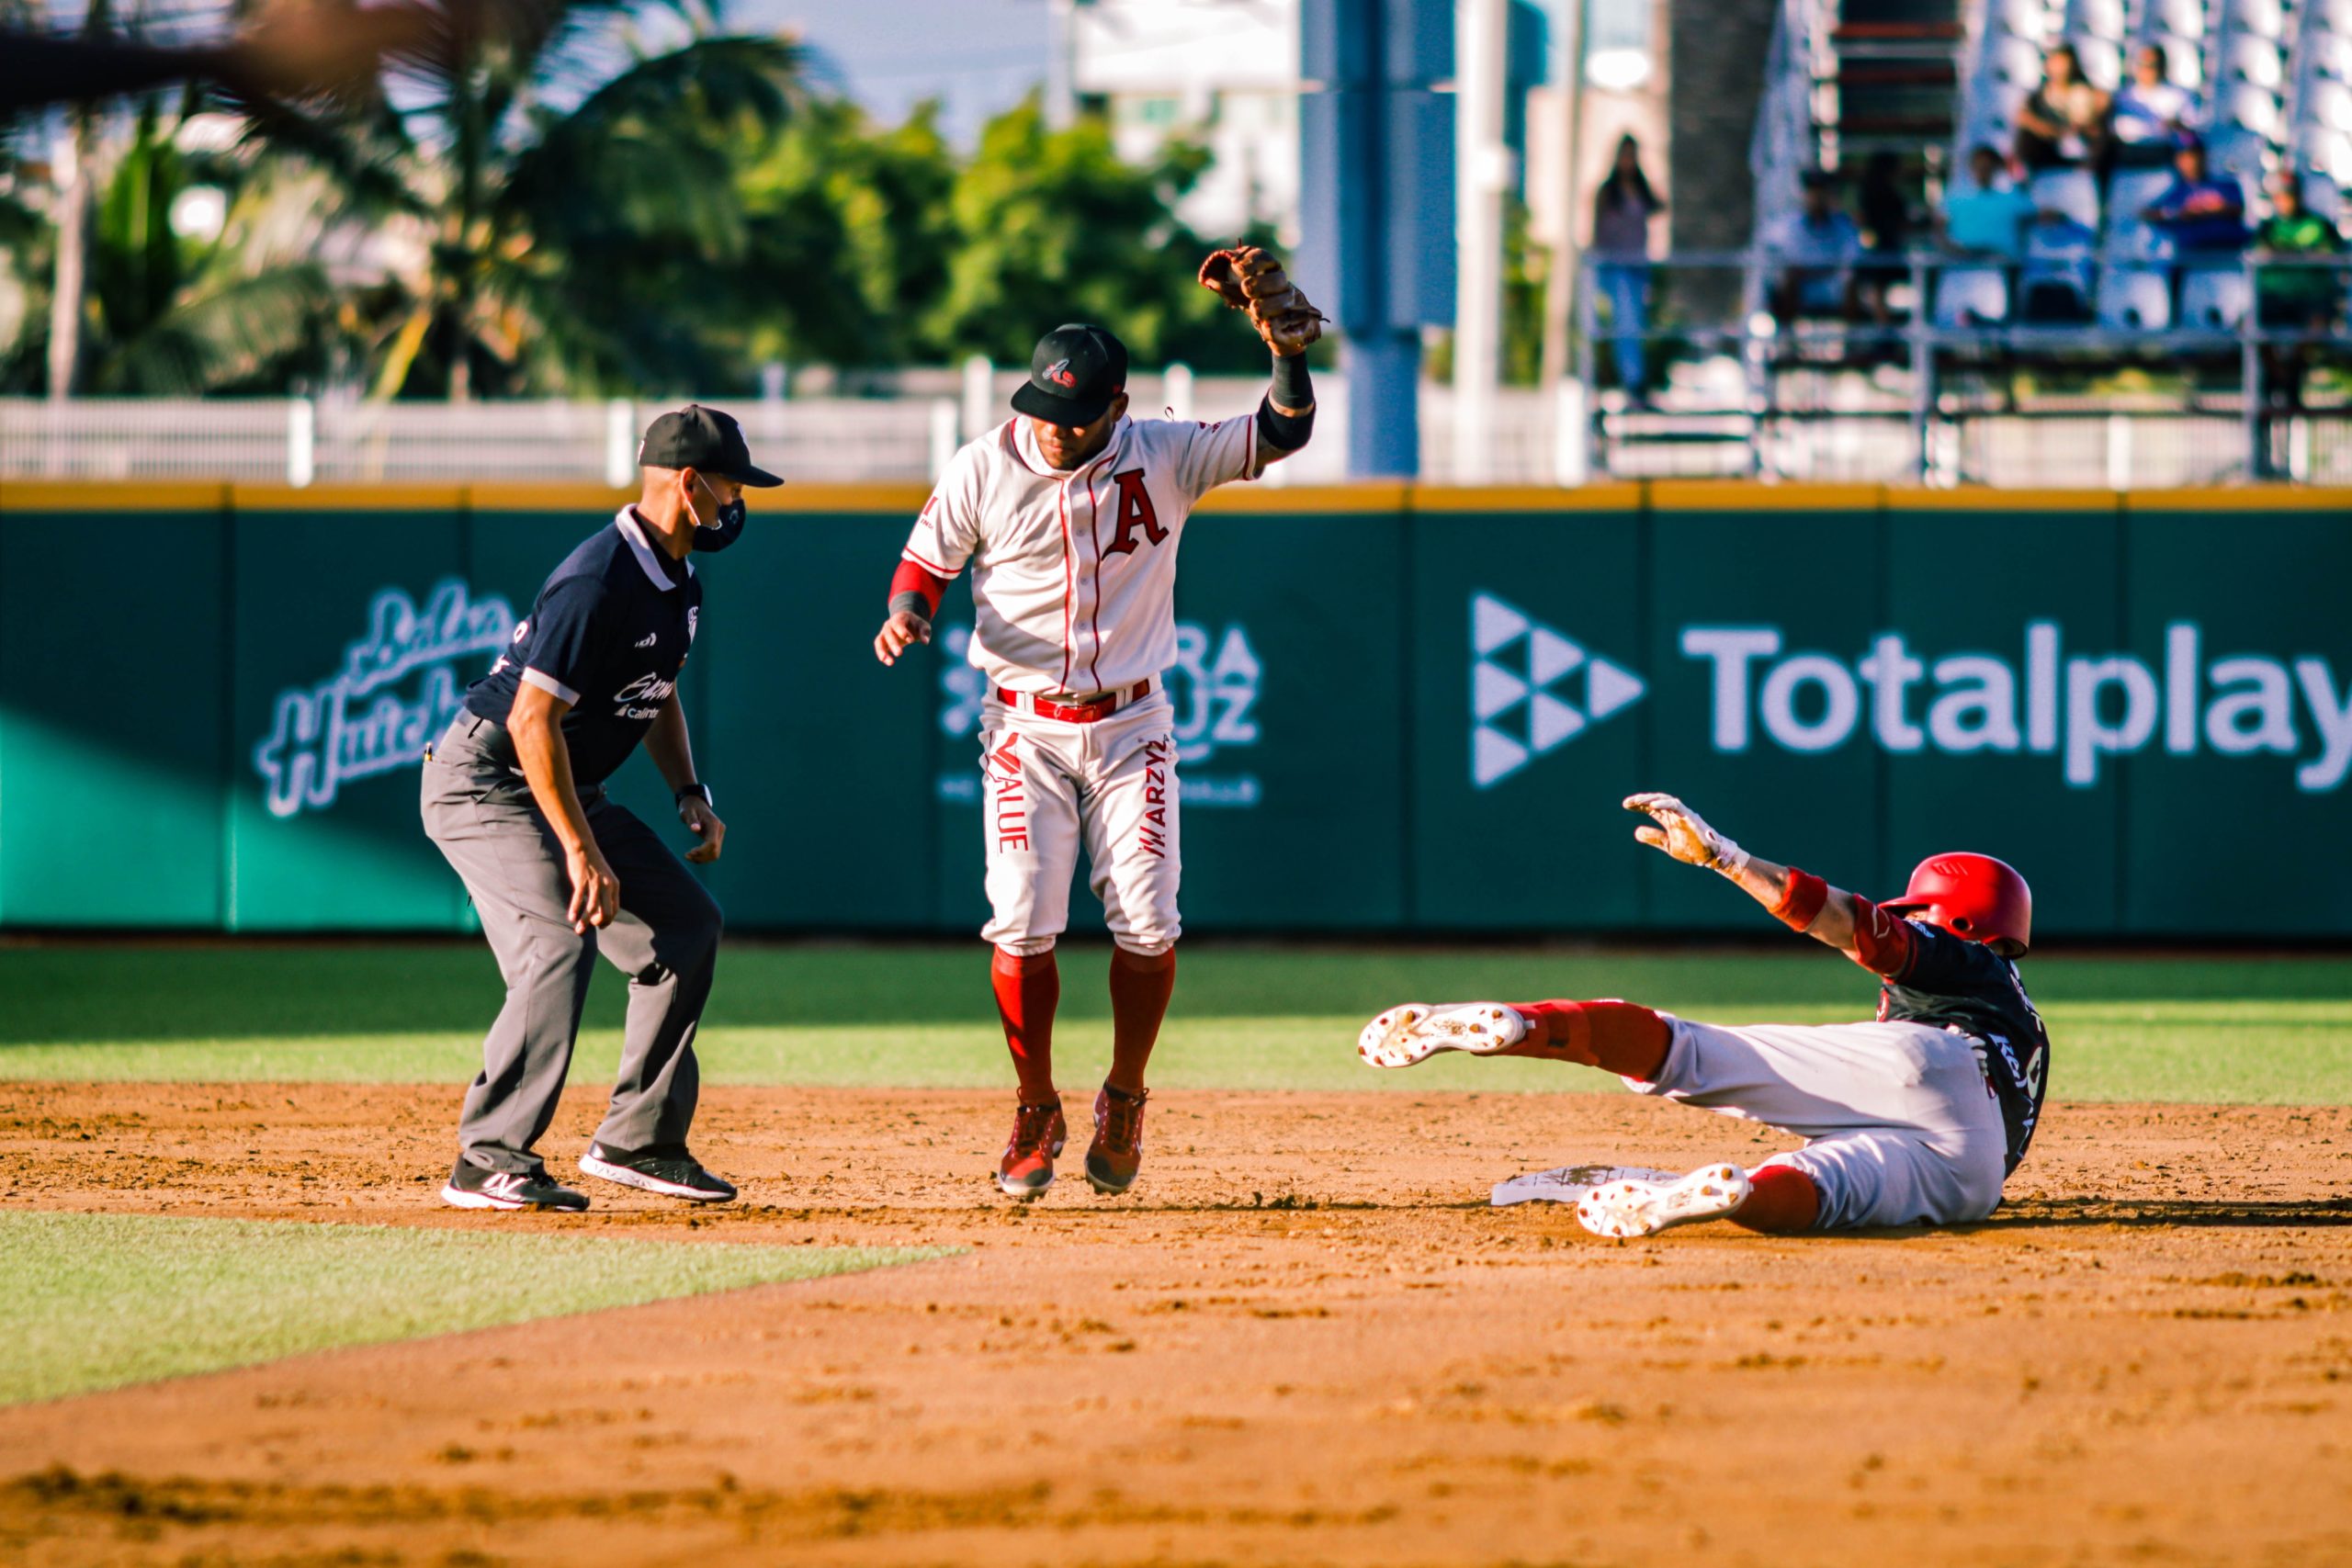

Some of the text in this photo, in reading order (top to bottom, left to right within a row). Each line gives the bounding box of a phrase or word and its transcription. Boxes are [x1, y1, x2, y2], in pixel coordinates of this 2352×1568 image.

[1101, 468, 1170, 561] A
[1175, 626, 1260, 681] RA
[1682, 623, 2352, 789] Totalplay
[990, 732, 1029, 854] VALUE
